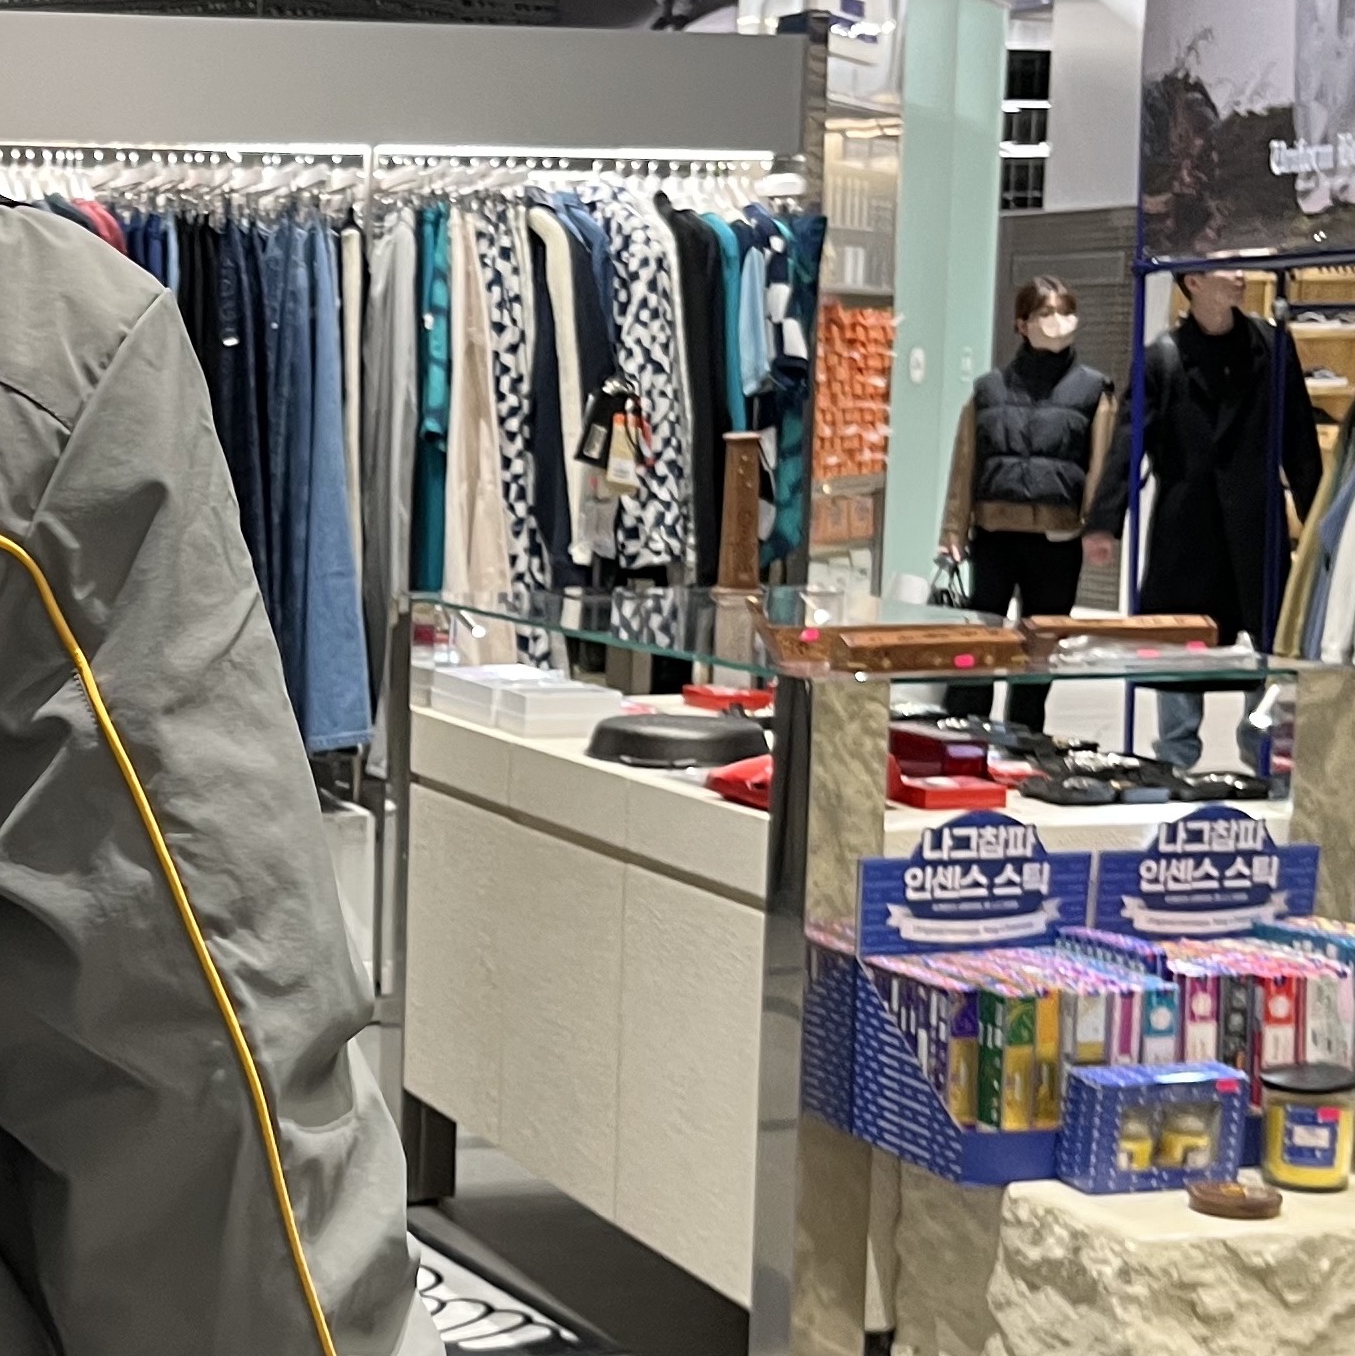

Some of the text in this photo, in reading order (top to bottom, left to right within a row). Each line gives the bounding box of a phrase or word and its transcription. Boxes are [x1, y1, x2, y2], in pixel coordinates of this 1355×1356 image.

[904, 862, 1051, 900] 인센스 스틱
[1139, 855, 1280, 892] 인센스 스틱
